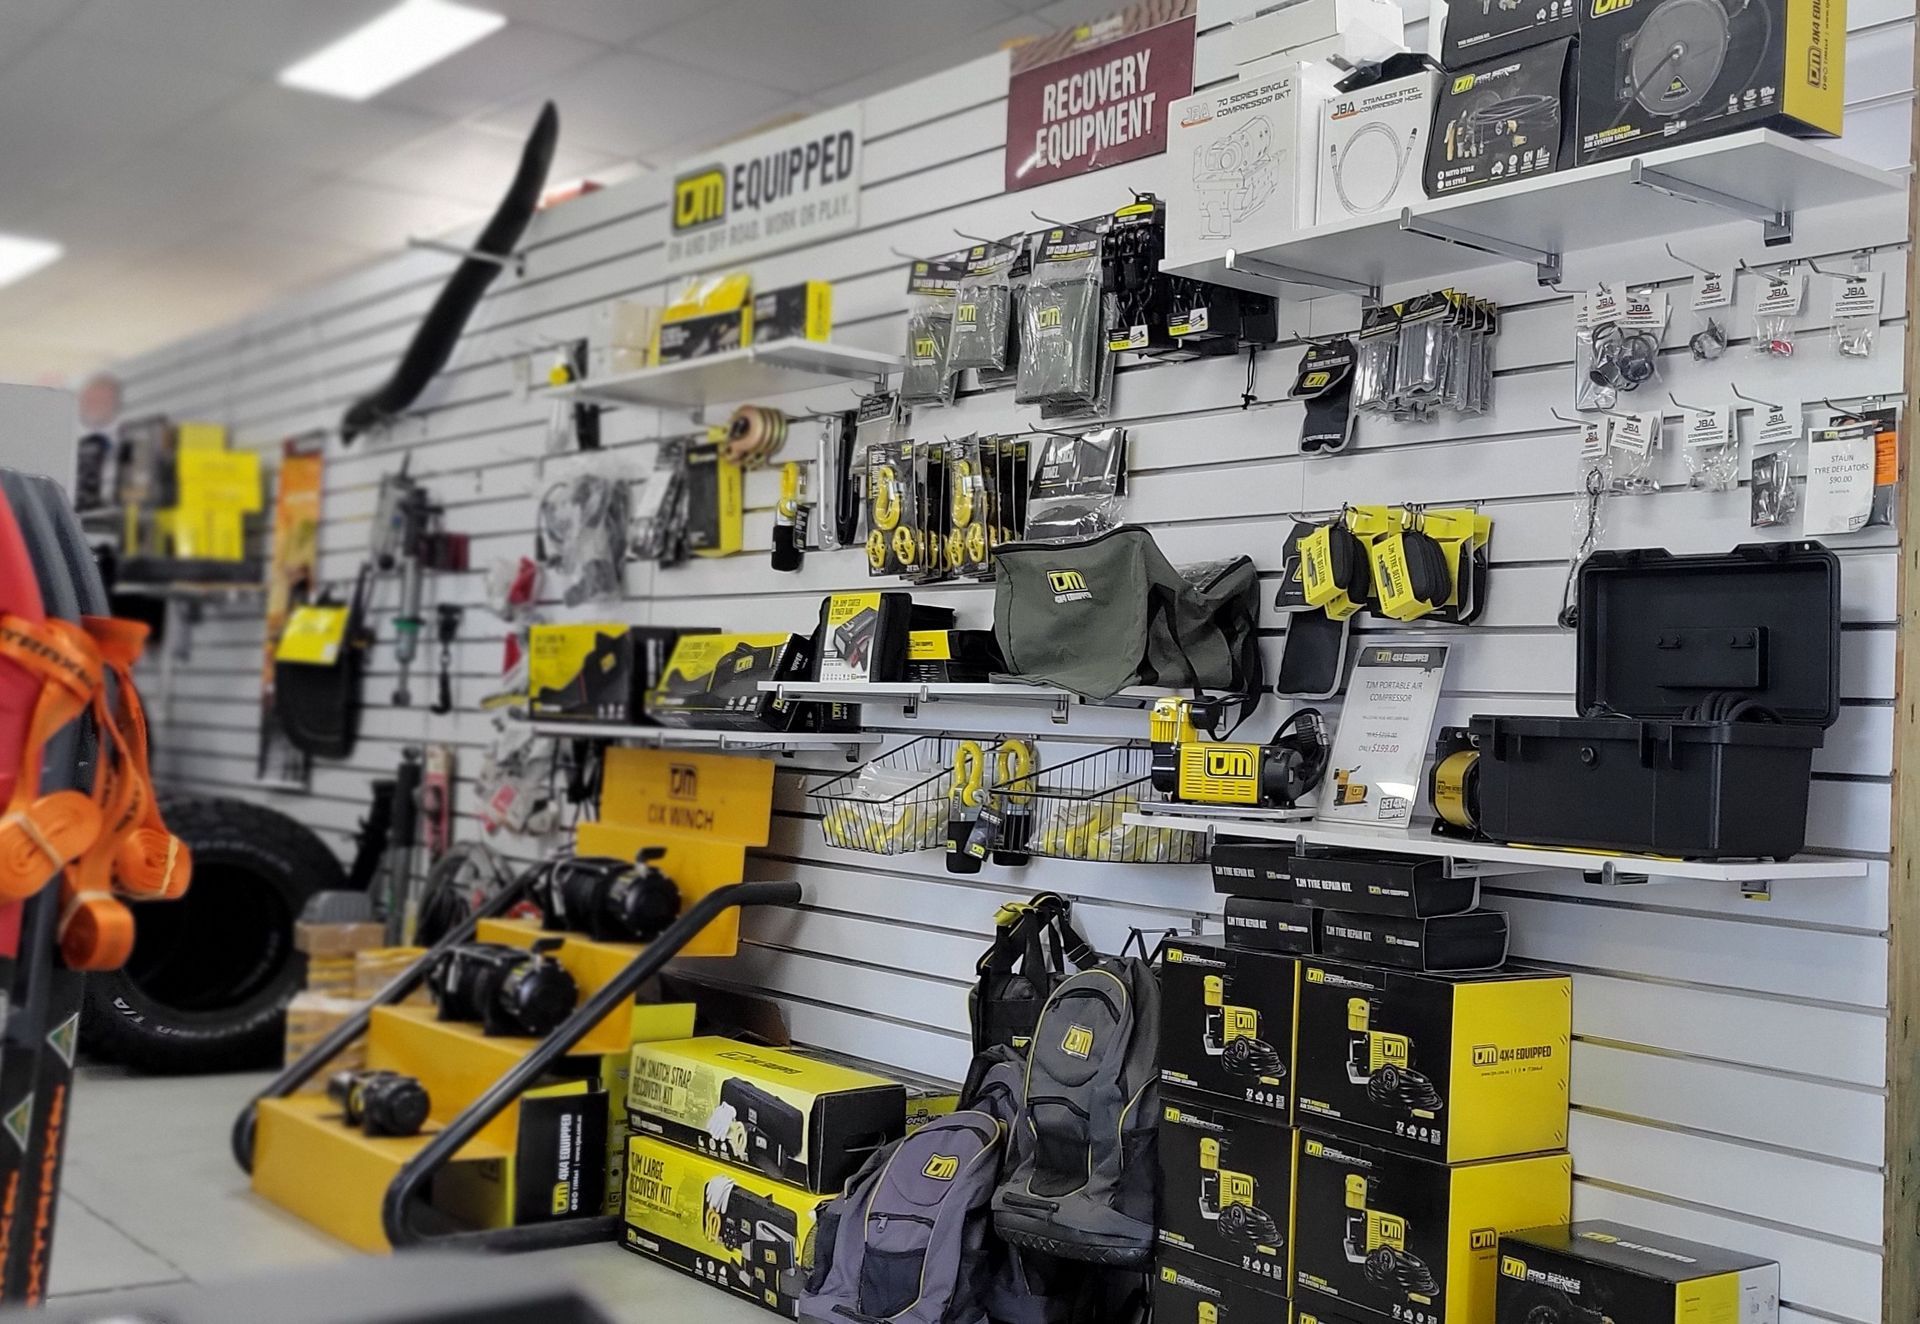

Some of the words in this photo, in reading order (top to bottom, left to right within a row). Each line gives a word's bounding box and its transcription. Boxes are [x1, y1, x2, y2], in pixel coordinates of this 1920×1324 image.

[1042, 48, 1151, 125] RECOVERY
[1260, 79, 1289, 95] SINGLE
[1216, 96, 1273, 118] COMPRESSOR
[1333, 102, 1355, 116] JBA
[1035, 92, 1156, 169] EQUIPMENT
[731, 129, 854, 213] EQUIPPED
[1768, 288, 1788, 298] JBA
[1844, 287, 1865, 297] JBA
[1629, 304, 1651, 312] JBA
[1696, 419, 1715, 429] JBA
[1768, 415, 1784, 425] JBA
[1624, 424, 1639, 433] JBA
[1814, 467, 1830, 475] TYRE
[1832, 463, 1869, 474] DEFLATORS
[1389, 555, 1399, 570] TYRE
[1366, 681, 1378, 689] TJM
[1378, 681, 1411, 690] PORTABLE
[1412, 682, 1423, 690] AIR
[1369, 693, 1412, 702] COMPRESSOR
[670, 805, 715, 831] WINCH
[1307, 879, 1321, 889] TYRE
[1321, 880, 1341, 891] REPAIR
[1335, 927, 1347, 938] TYRE
[1347, 929, 1363, 940] REPAIR
[1499, 1049, 1514, 1061] 4X4
[1516, 1046, 1552, 1059] EQUIPPED
[647, 1059, 671, 1083] SNATCH
[671, 1066, 692, 1089] STRAP
[632, 1076, 662, 1101] RECOVERY
[663, 1085, 674, 1106] KIT
[559, 1114, 572, 1160] EQUIPPED
[644, 1156, 664, 1181] LARGE
[631, 1173, 659, 1201] RECOVERY
[660, 1184, 672, 1206] KIT
[1527, 1269, 1546, 1280] PRO
